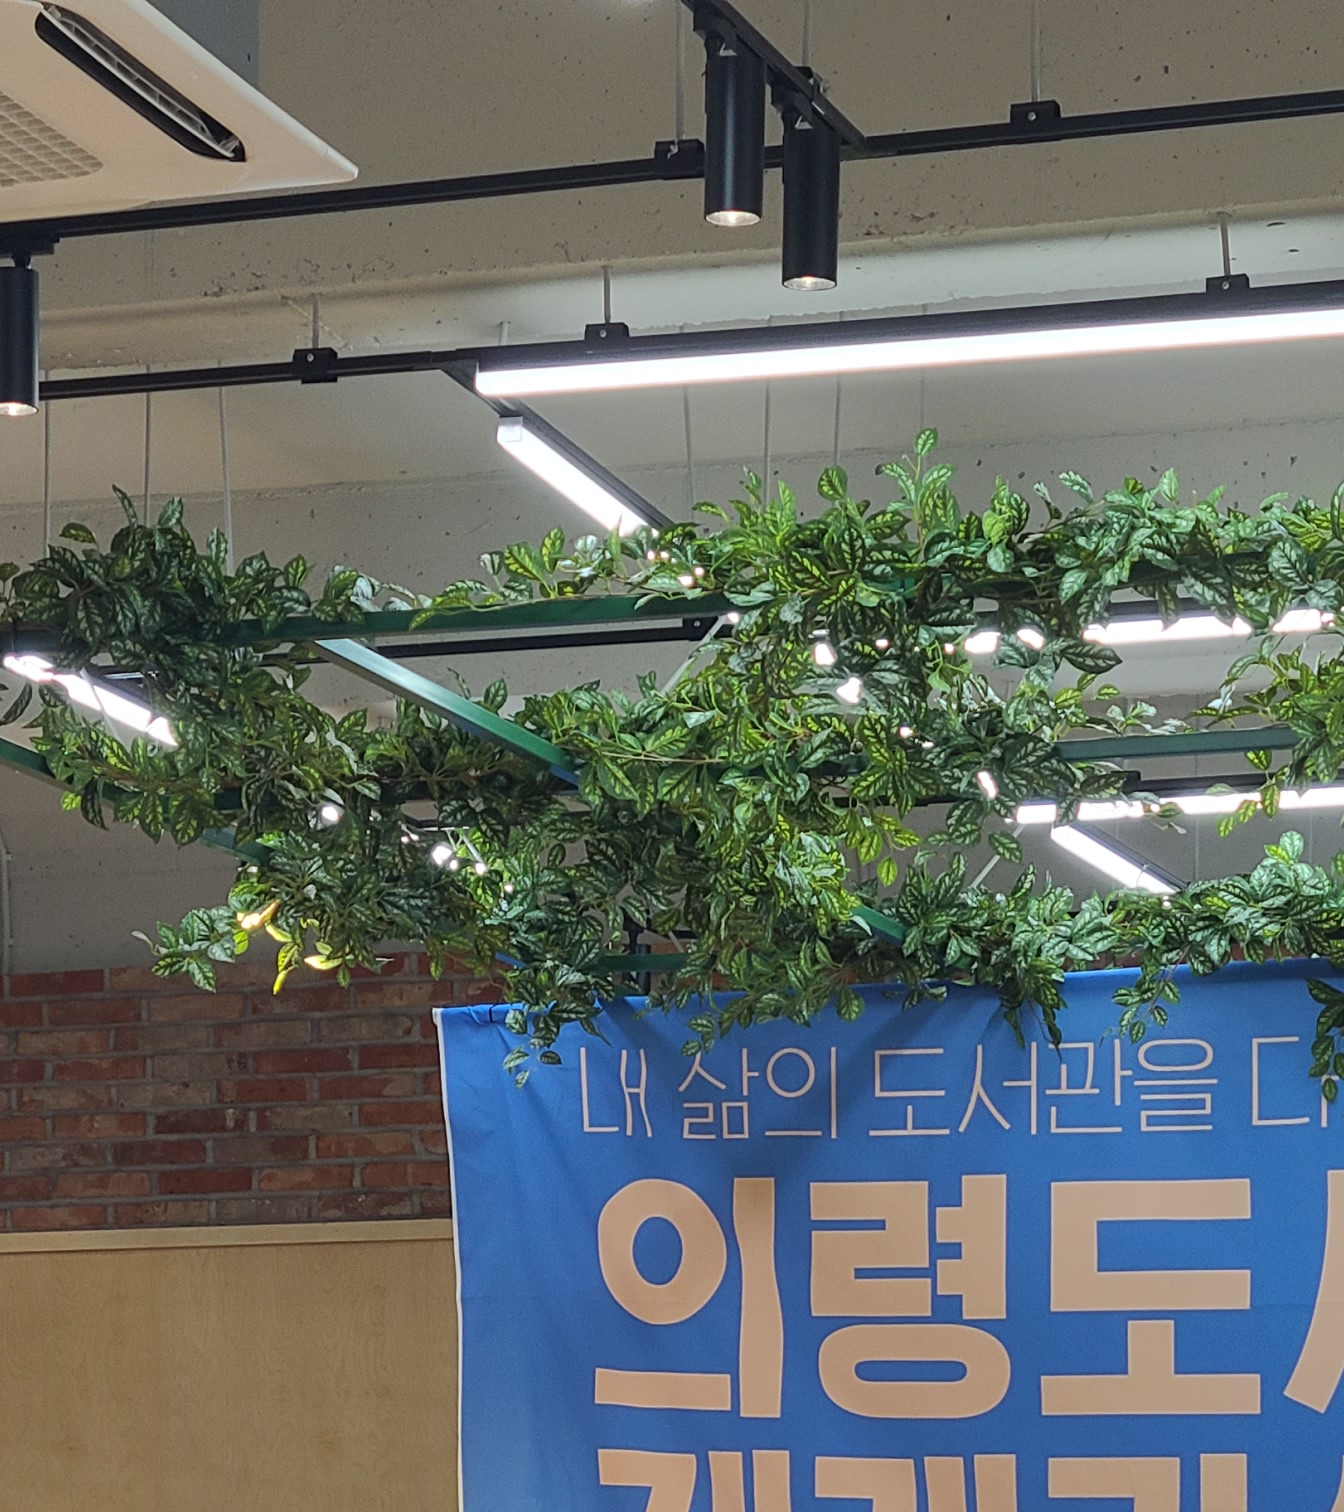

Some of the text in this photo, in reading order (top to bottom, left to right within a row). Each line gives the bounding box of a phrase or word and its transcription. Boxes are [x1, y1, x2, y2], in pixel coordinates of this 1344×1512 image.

[579, 1046, 653, 1138] 내
[678, 1045, 837, 1141] 삶의
[868, 1038, 1219, 1137] 도서관을
